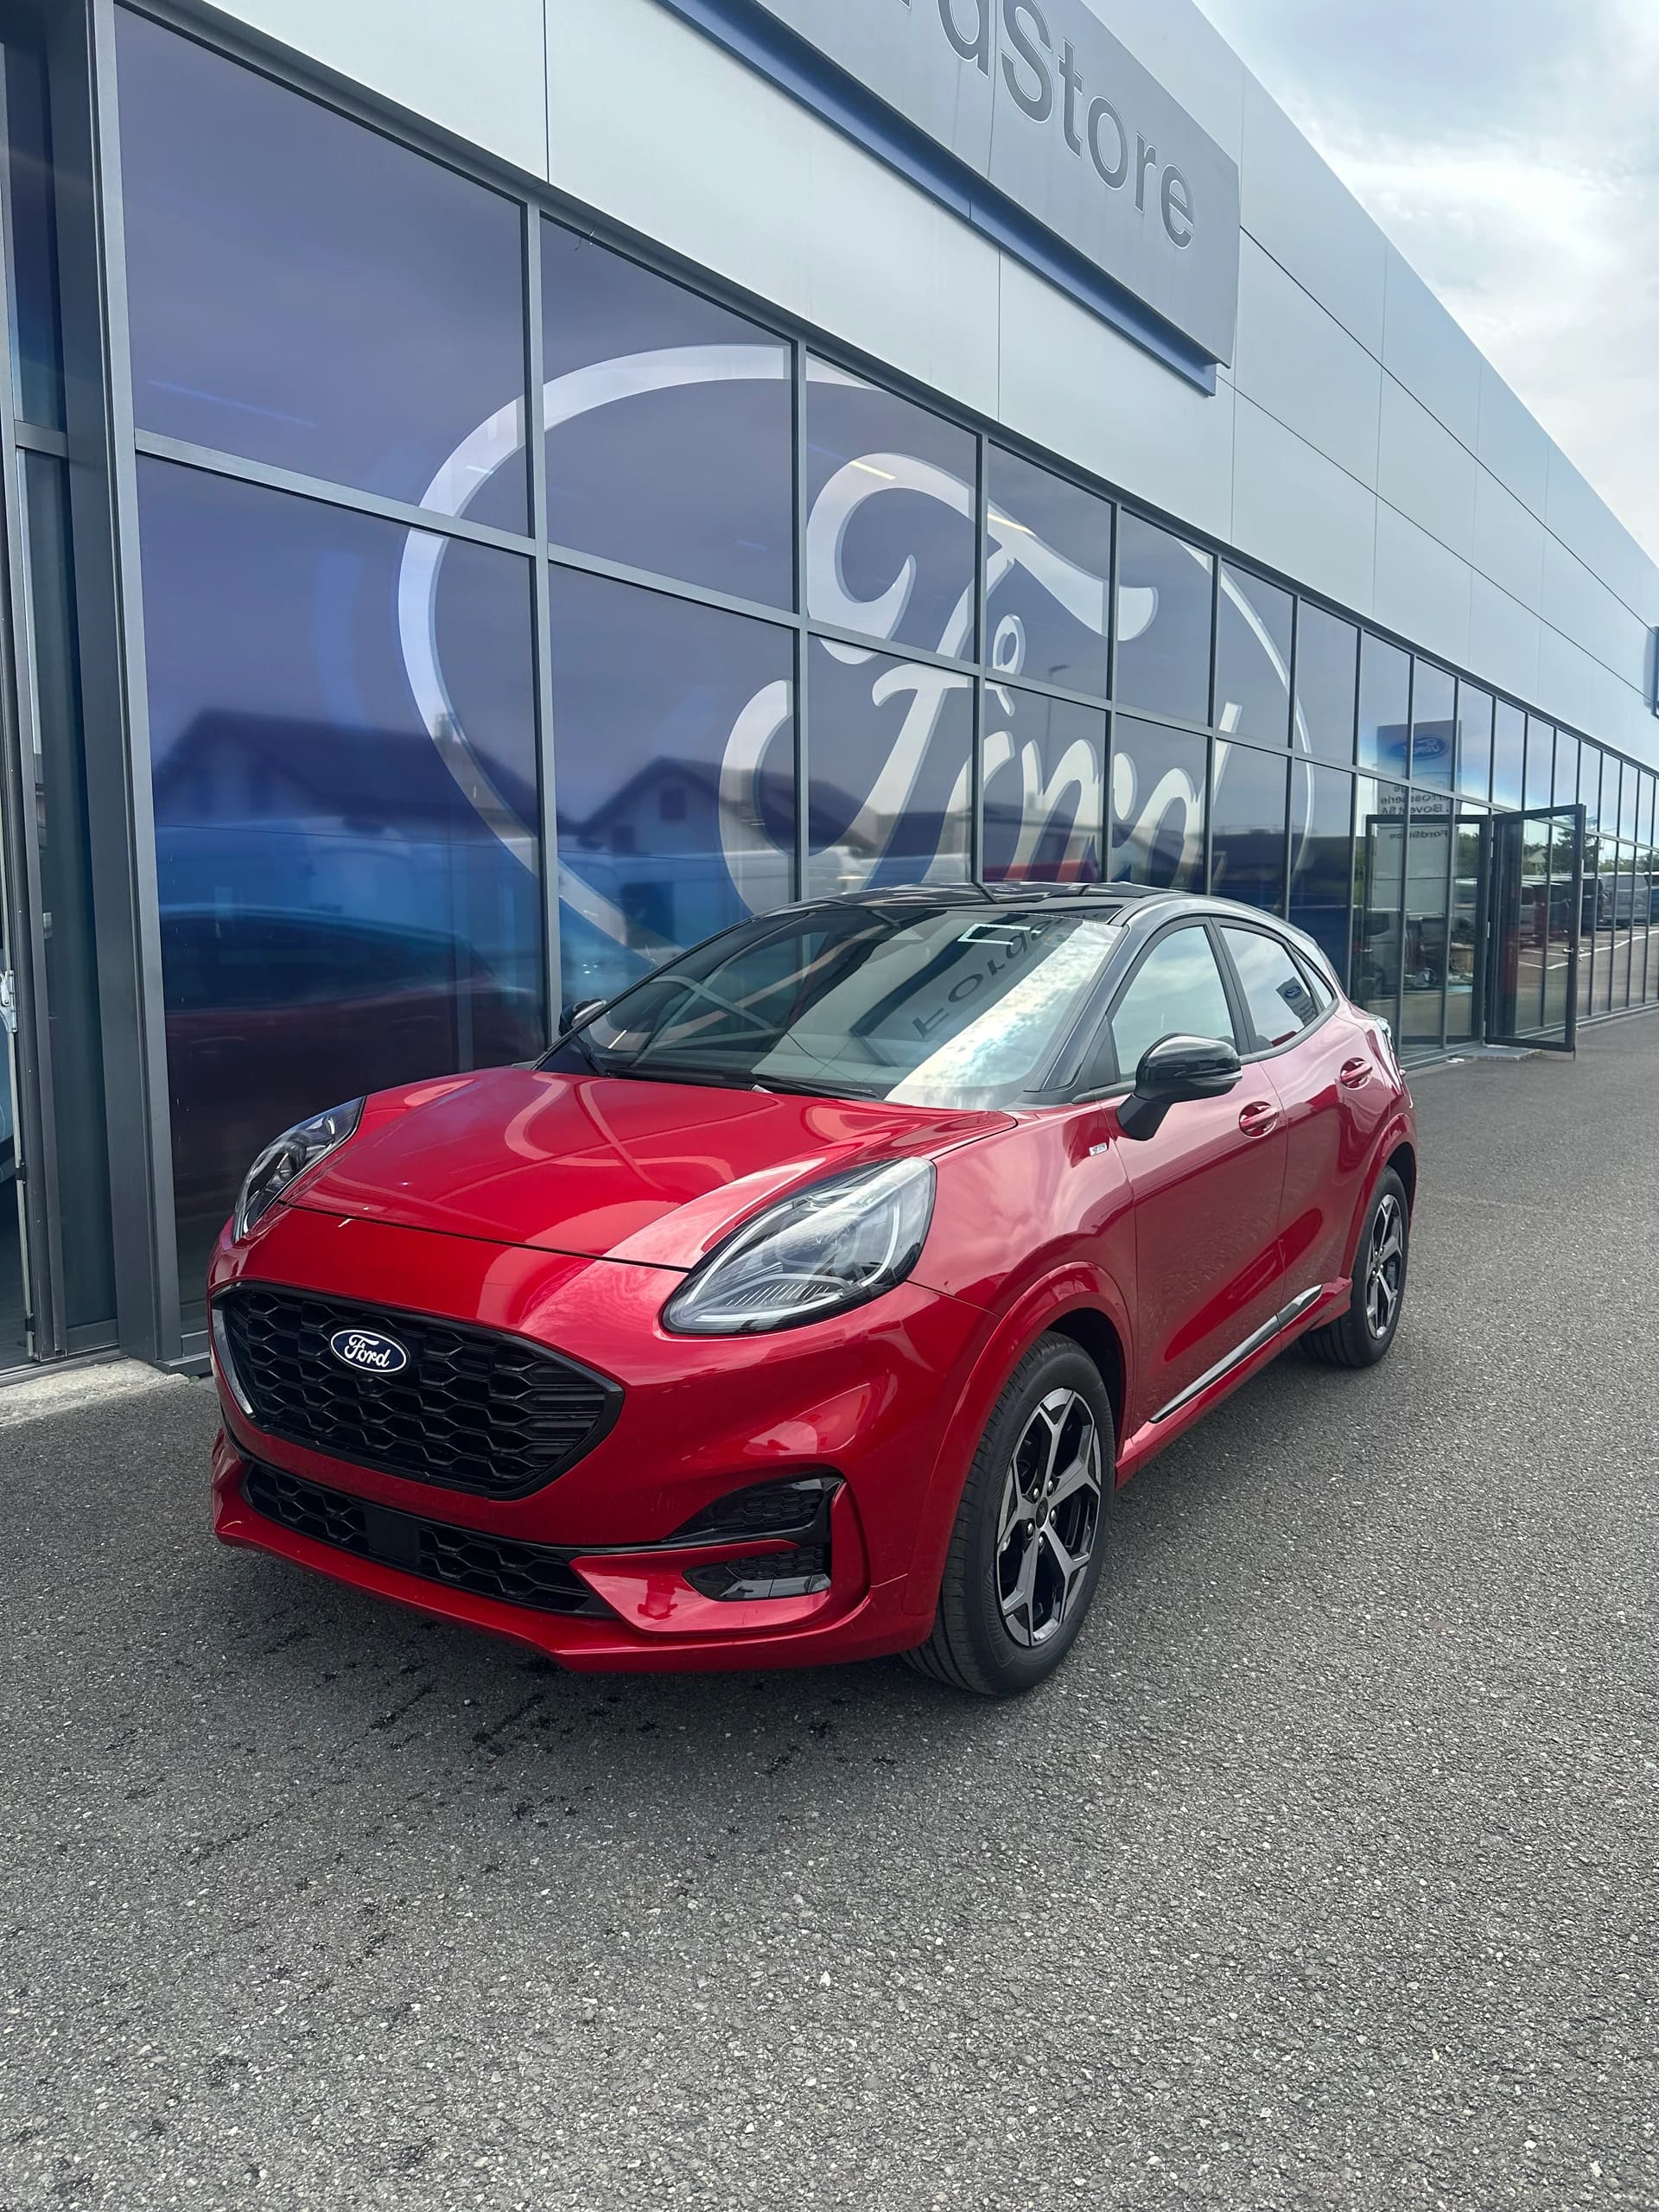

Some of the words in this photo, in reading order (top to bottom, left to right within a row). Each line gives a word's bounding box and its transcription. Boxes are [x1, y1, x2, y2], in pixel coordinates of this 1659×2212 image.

[899, 0, 1195, 249] dStore
[719, 453, 1243, 914] Ford
[344, 1334, 391, 1368] Ford
